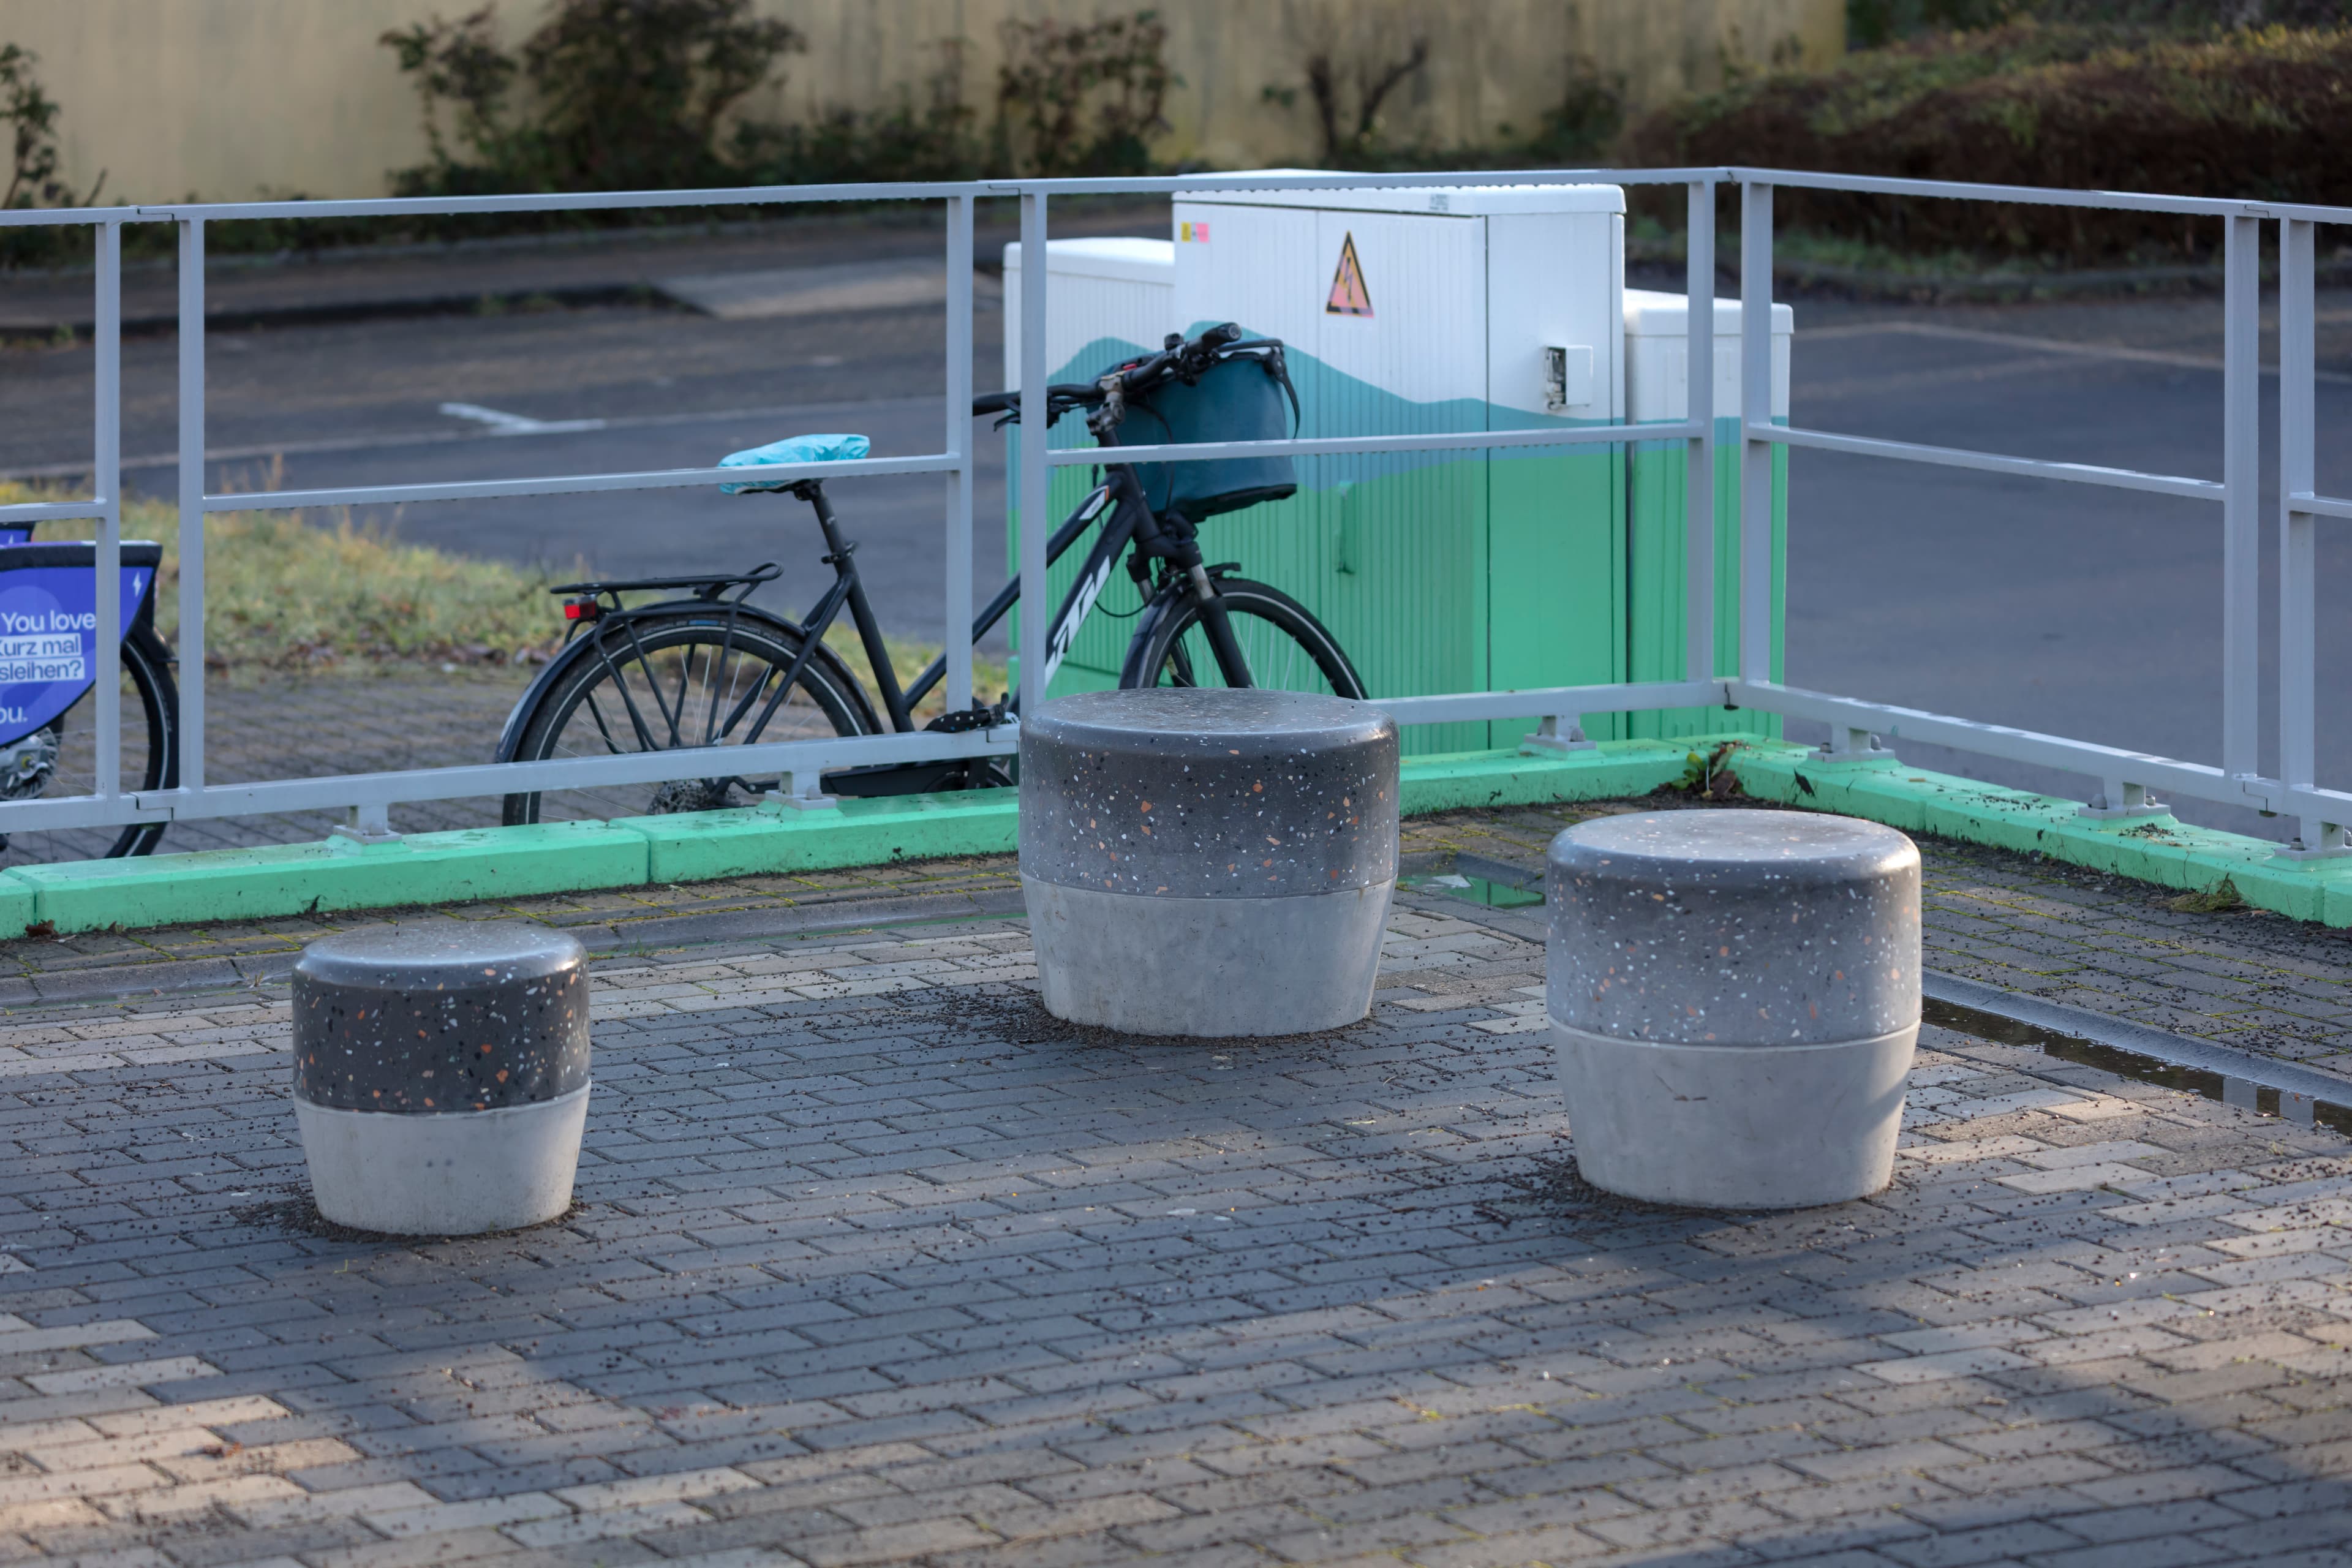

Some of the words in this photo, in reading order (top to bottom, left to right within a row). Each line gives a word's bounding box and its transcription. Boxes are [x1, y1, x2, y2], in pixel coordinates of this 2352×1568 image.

[1, 612, 45, 633] You
[50, 609, 96, 631] love
[42, 635, 79, 654] mal
